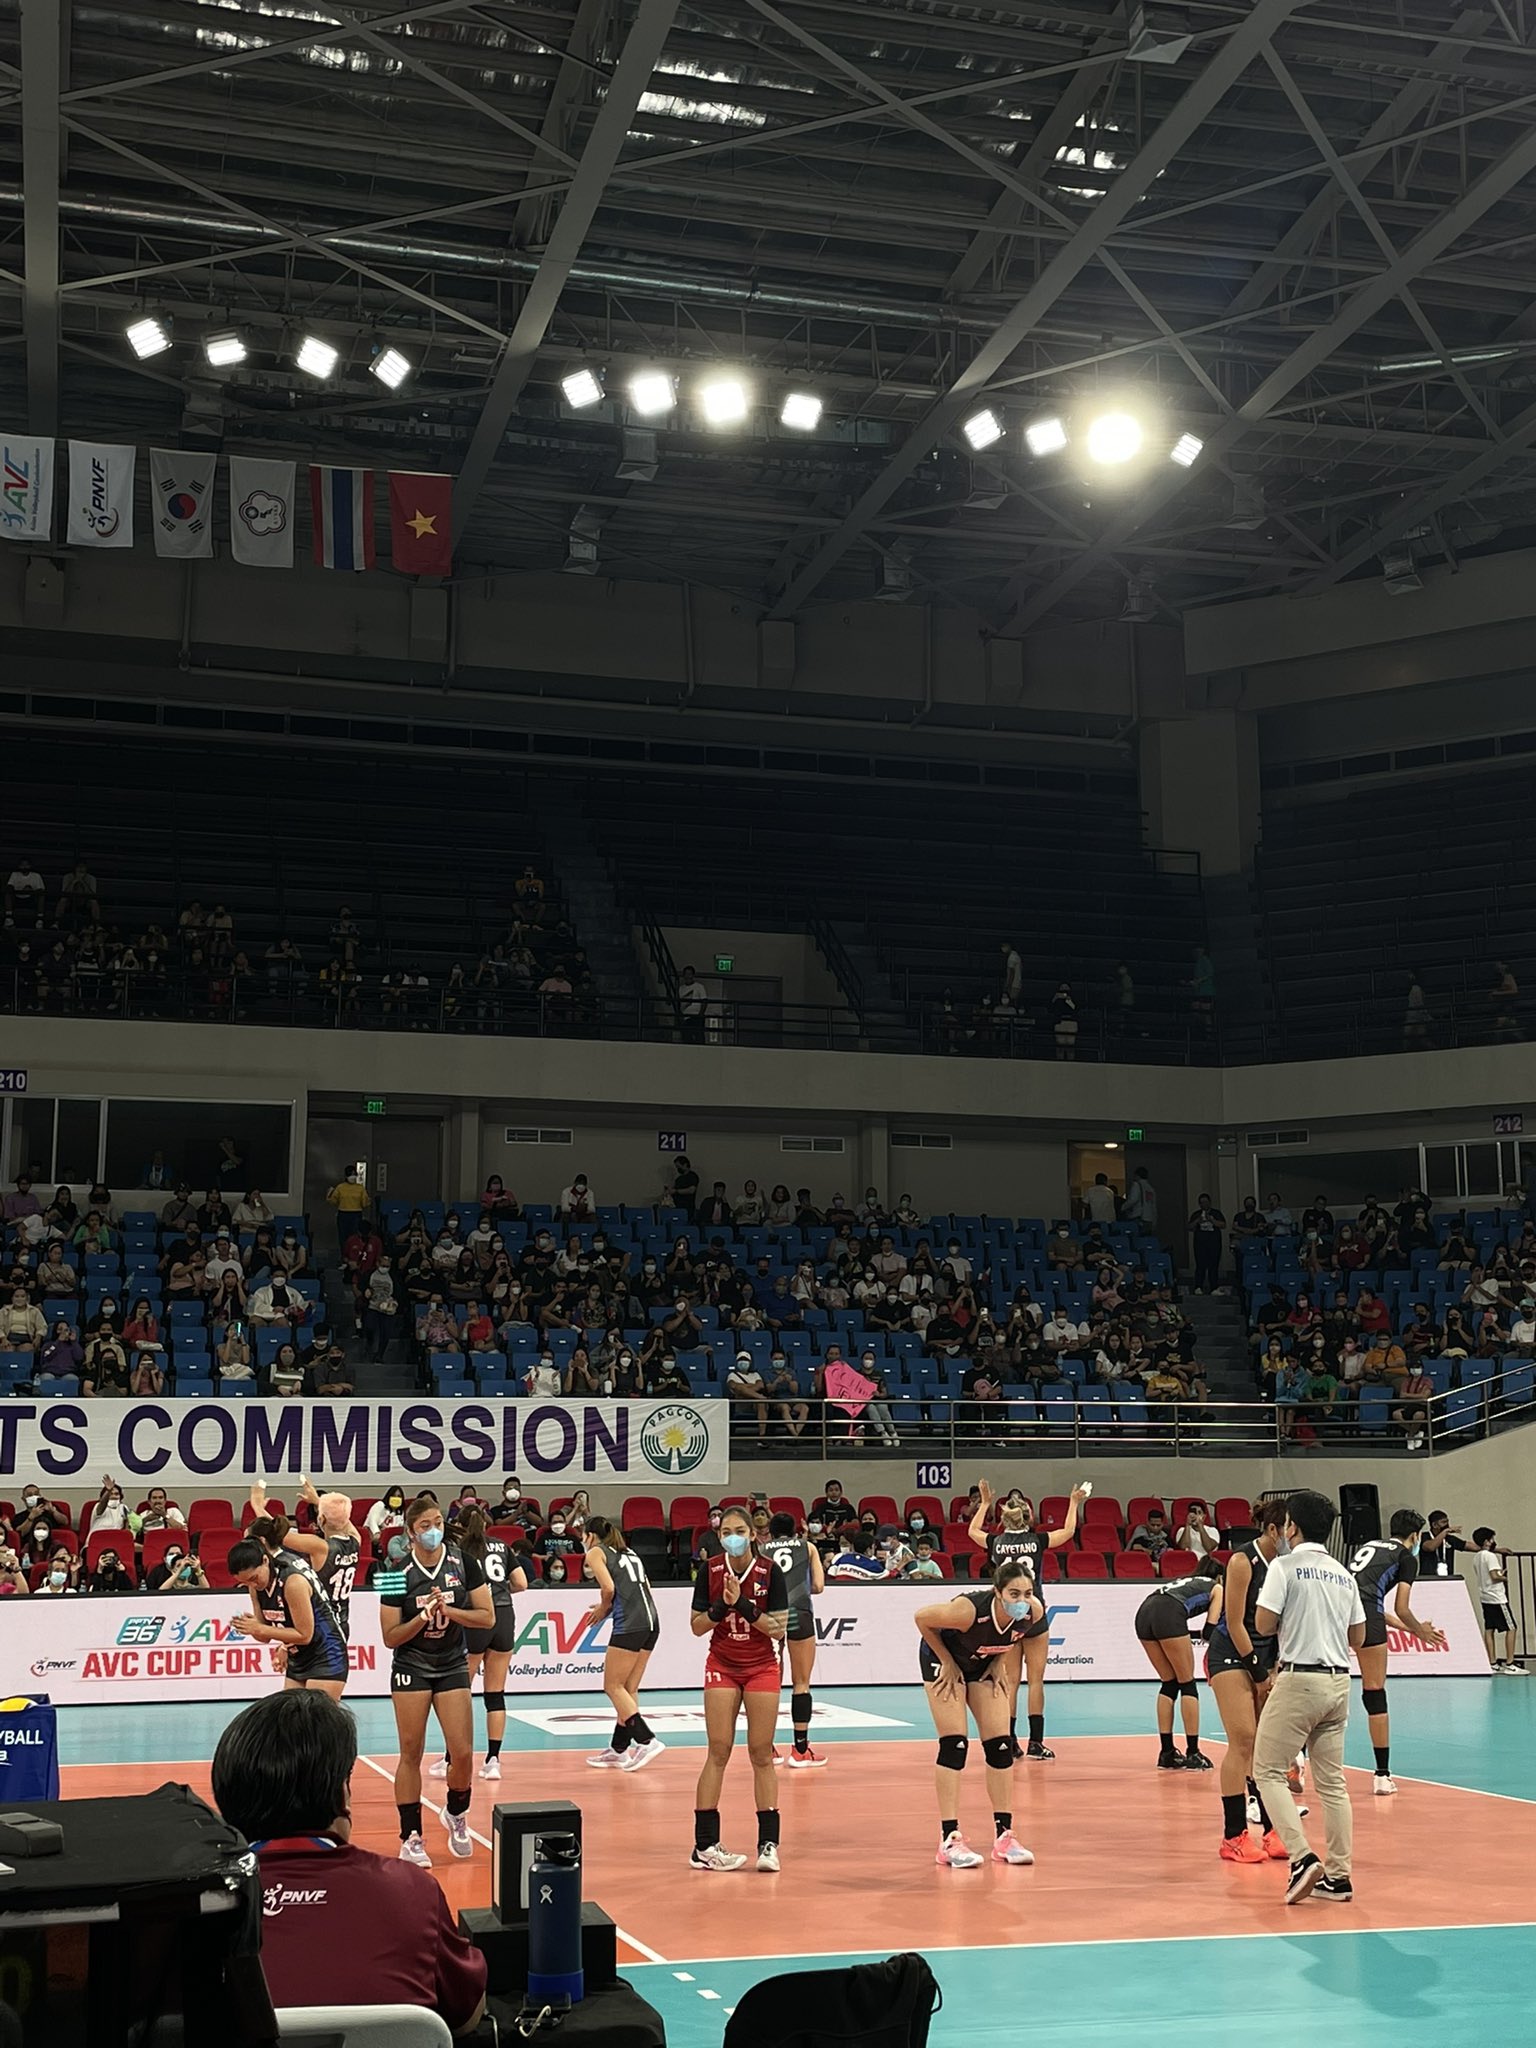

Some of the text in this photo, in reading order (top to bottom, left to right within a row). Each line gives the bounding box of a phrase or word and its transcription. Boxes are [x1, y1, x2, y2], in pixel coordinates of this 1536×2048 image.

[3, 447, 30, 514] AVC
[92, 457, 105, 512] PNVF
[1495, 1117, 1521, 1132] 212
[659, 1135, 685, 1149] 211
[649, 1408, 701, 1428] PAGCOR
[0, 1405, 629, 1475] TS COMMISSION
[918, 1465, 950, 1485] 103
[765, 1540, 801, 1549] PANAGA
[995, 1542, 1037, 1555] CAYETANO
[618, 1554, 645, 1583] 17
[773, 1547, 793, 1573] 6
[1350, 1547, 1376, 1571] 9
[329, 1567, 356, 1600] 18
[1296, 1567, 1353, 1590] PHILIPPINES
[120, 1625, 157, 1642] 36
[815, 1618, 858, 1640] VF
[82, 1652, 139, 1678] AVC
[147, 1650, 201, 1676] CUP
[210, 1649, 262, 1674] FOR
[508, 1663, 563, 1677] Volleyball
[280, 1890, 328, 1903] PNVF
